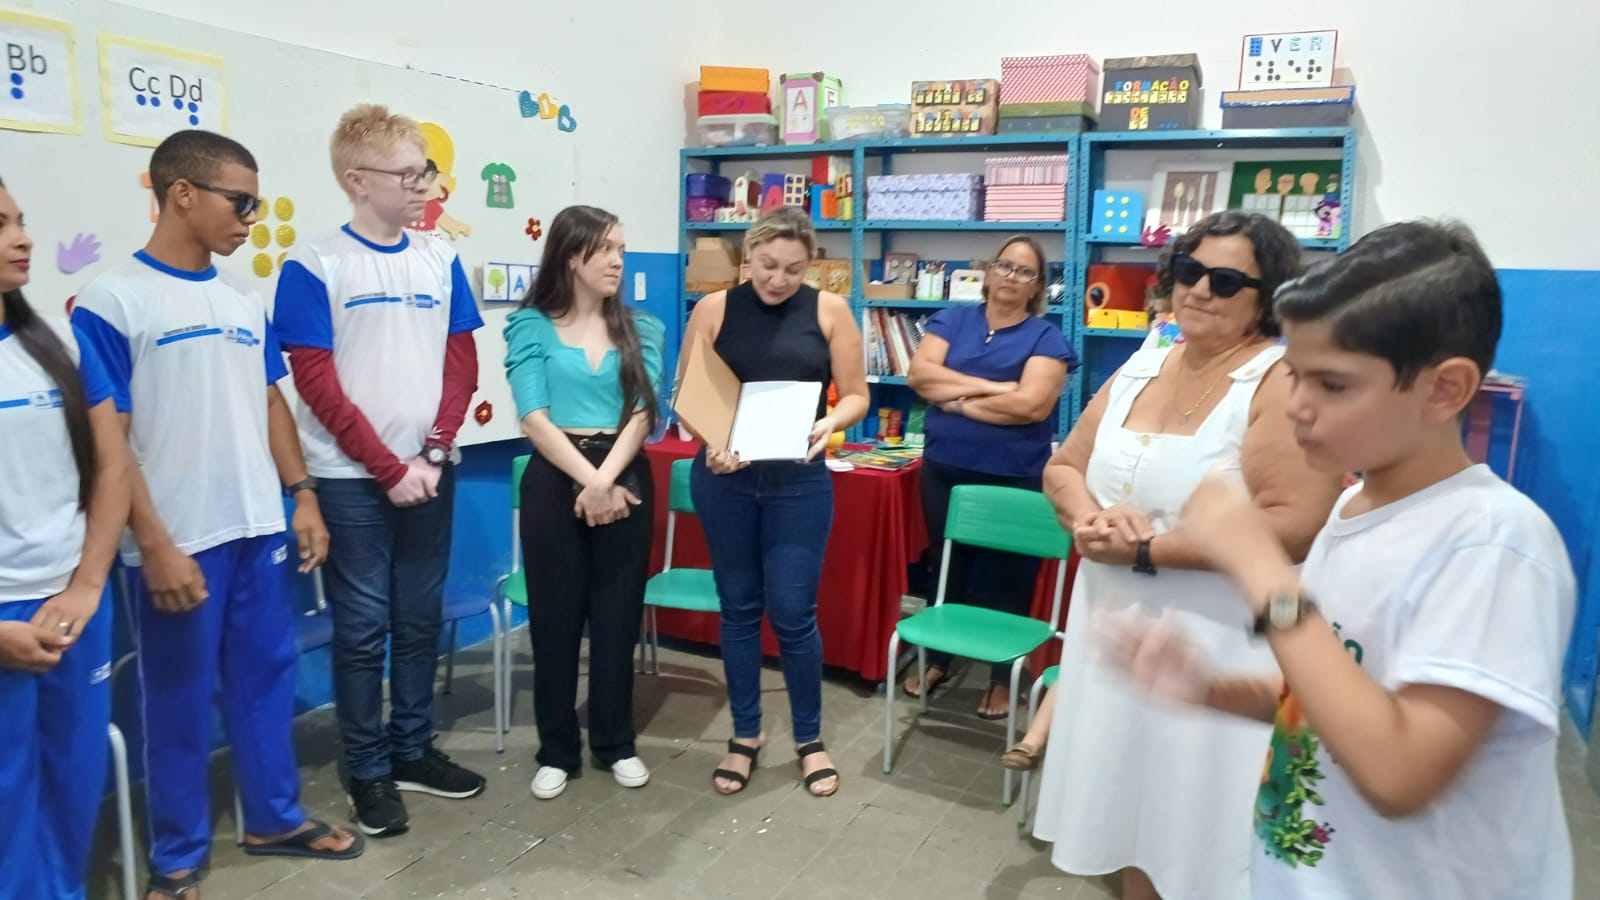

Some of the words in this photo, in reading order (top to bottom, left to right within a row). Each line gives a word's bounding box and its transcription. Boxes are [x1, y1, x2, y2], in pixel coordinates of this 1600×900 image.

[7, 42, 47, 75] Bb
[128, 66, 160, 95] Cc
[170, 74, 203, 103] Dd
[792, 89, 808, 112] A
[1130, 107, 1149, 120] DE
[513, 273, 526, 293] A
